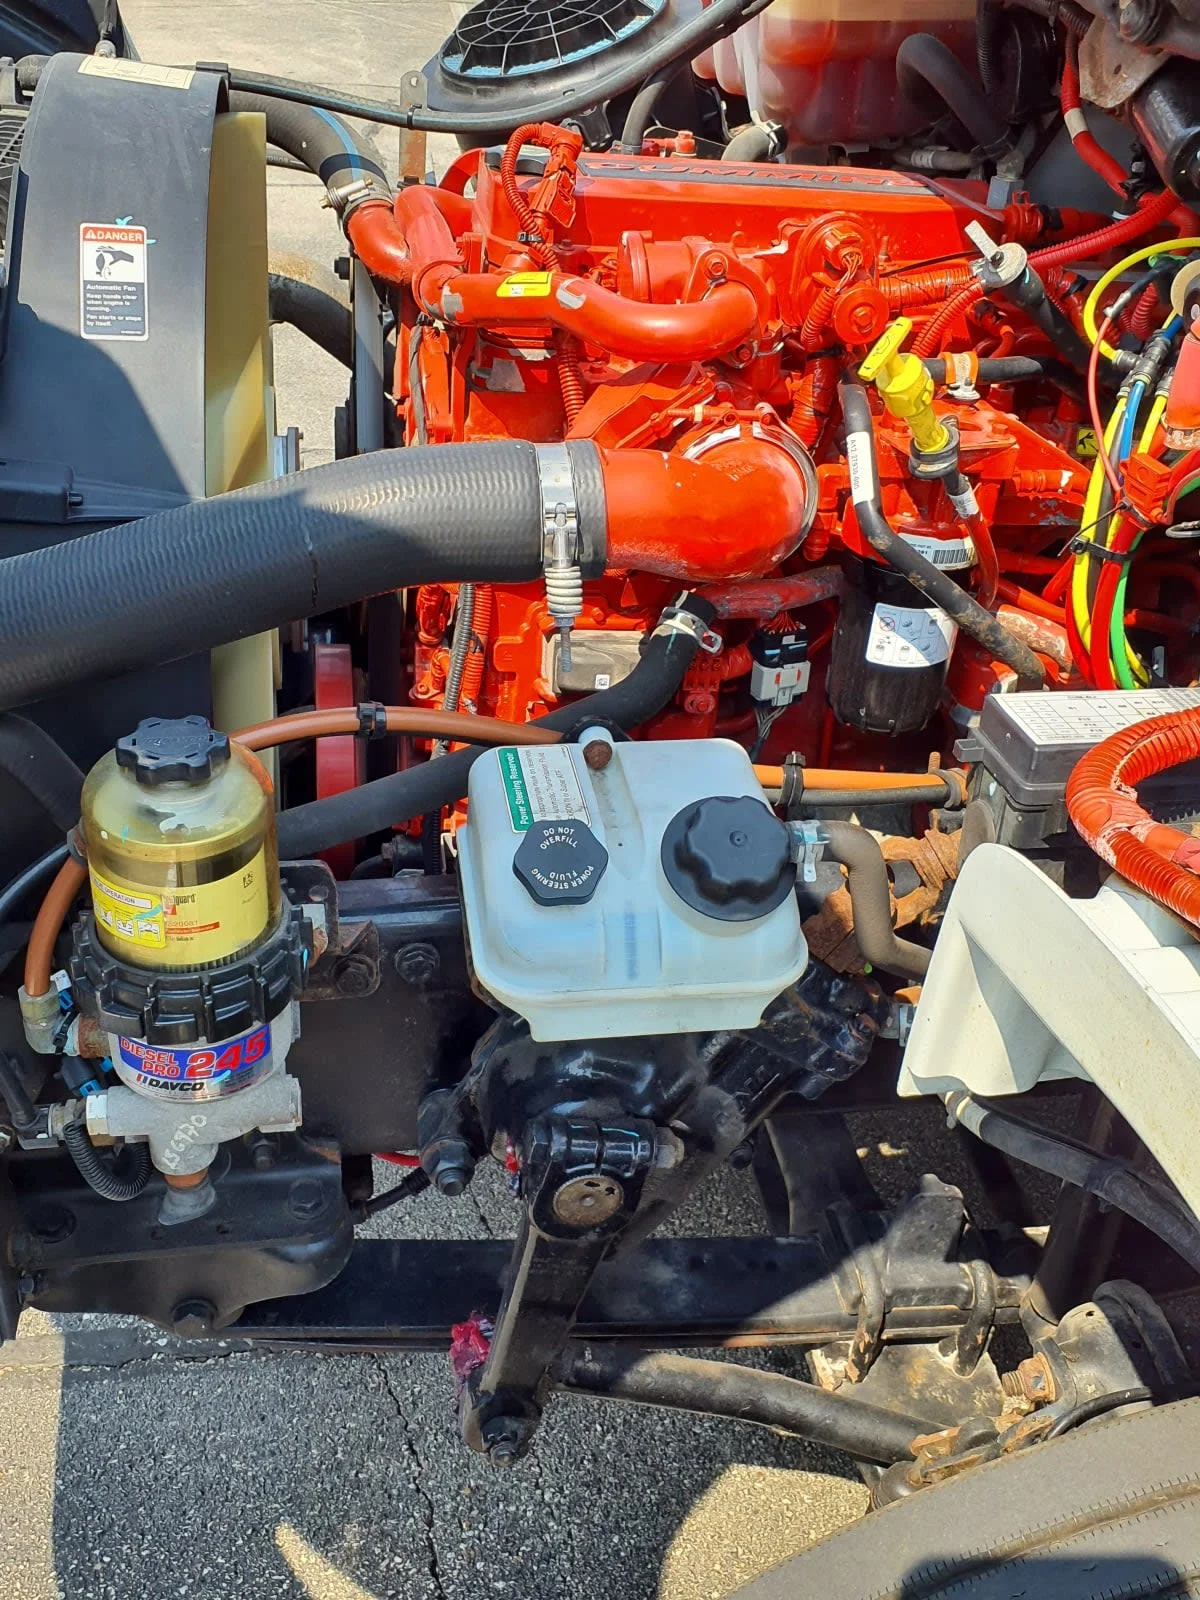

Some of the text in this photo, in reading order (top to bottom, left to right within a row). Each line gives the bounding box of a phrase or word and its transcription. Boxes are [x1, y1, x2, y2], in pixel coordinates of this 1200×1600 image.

[97, 231, 143, 242] DANGER
[506, 752, 530, 825] Power Steering Reservoir
[543, 827, 575, 837] DO NOT
[540, 835, 578, 850] OVERFILL
[531, 865, 594, 889] POWER STEERING
[549, 870, 578, 881] FLUID
[120, 1036, 180, 1066] DIESEL
[184, 1029, 267, 1079] 245
[142, 1060, 181, 1078] PRO
[148, 1079, 205, 1092] DAVCO
